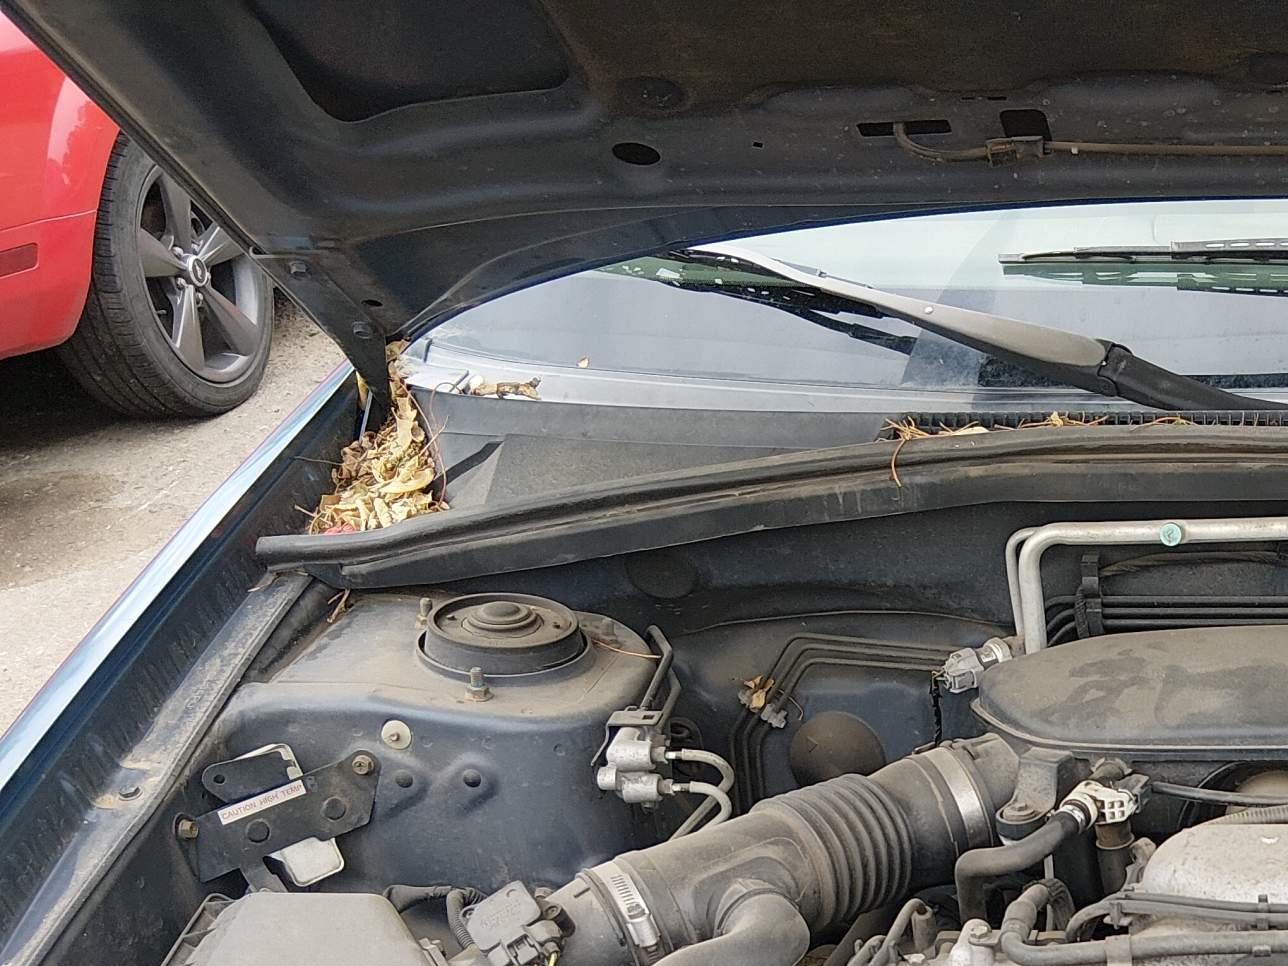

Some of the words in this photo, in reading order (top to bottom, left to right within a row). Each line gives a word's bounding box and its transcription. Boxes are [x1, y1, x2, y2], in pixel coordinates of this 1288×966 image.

[221, 801, 257, 820] CAUTION
[259, 793, 278, 806] HIGH
[282, 783, 303, 798] TEMP
